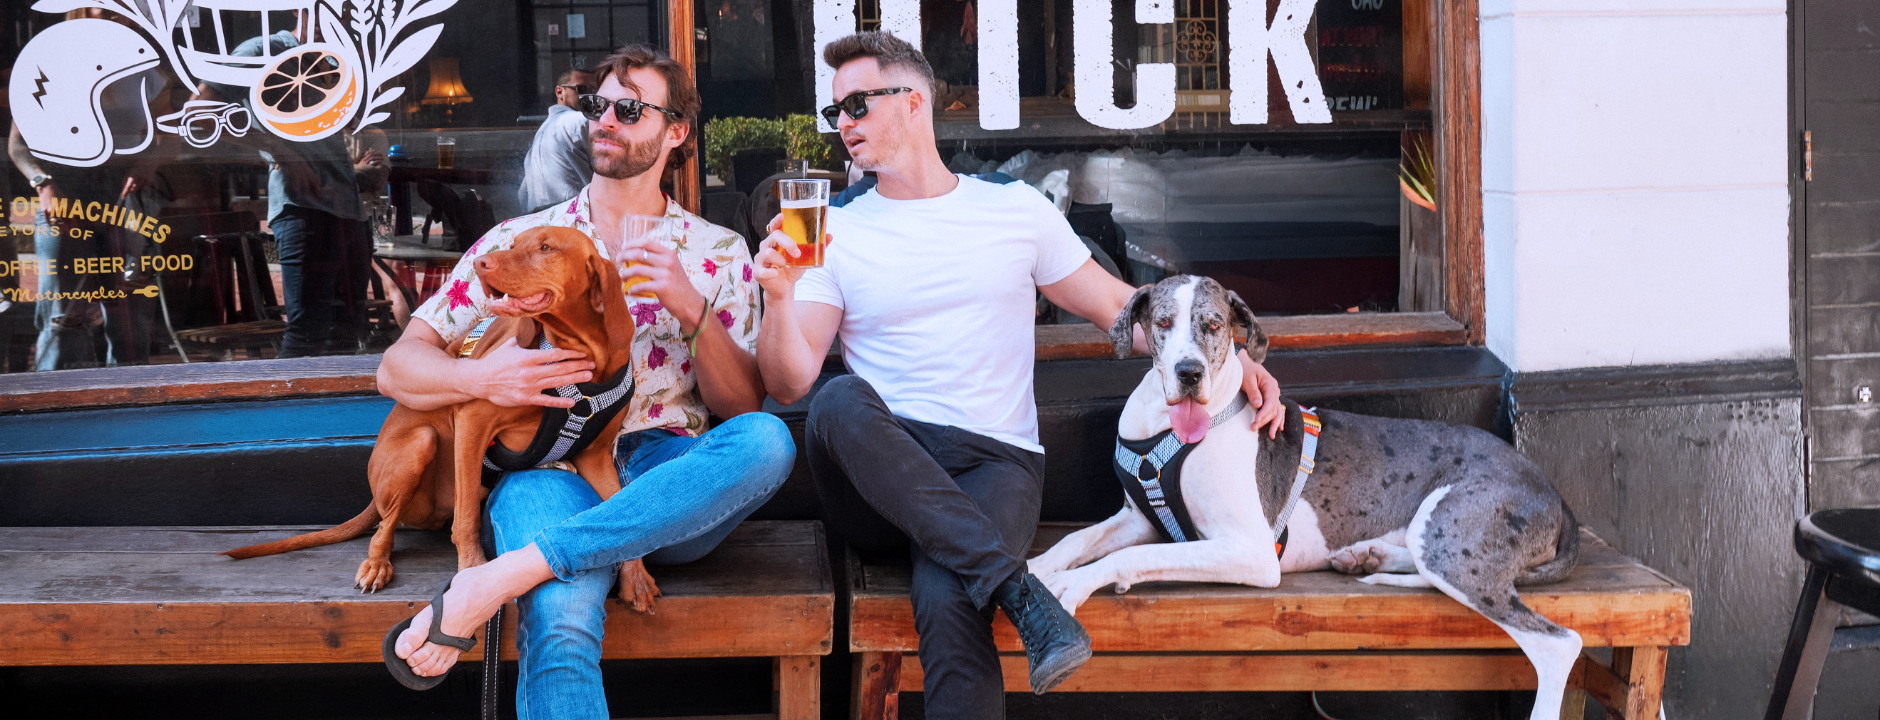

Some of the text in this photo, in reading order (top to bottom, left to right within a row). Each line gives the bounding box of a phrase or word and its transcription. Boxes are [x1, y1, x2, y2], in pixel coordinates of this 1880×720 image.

[12, 196, 42, 217] OF
[51, 197, 171, 244] MACHINES
[70, 227, 93, 241] OF
[74, 257, 125, 275] BEER
[141, 254, 193, 272] FOOD
[3, 286, 127, 303] Motorcycles
